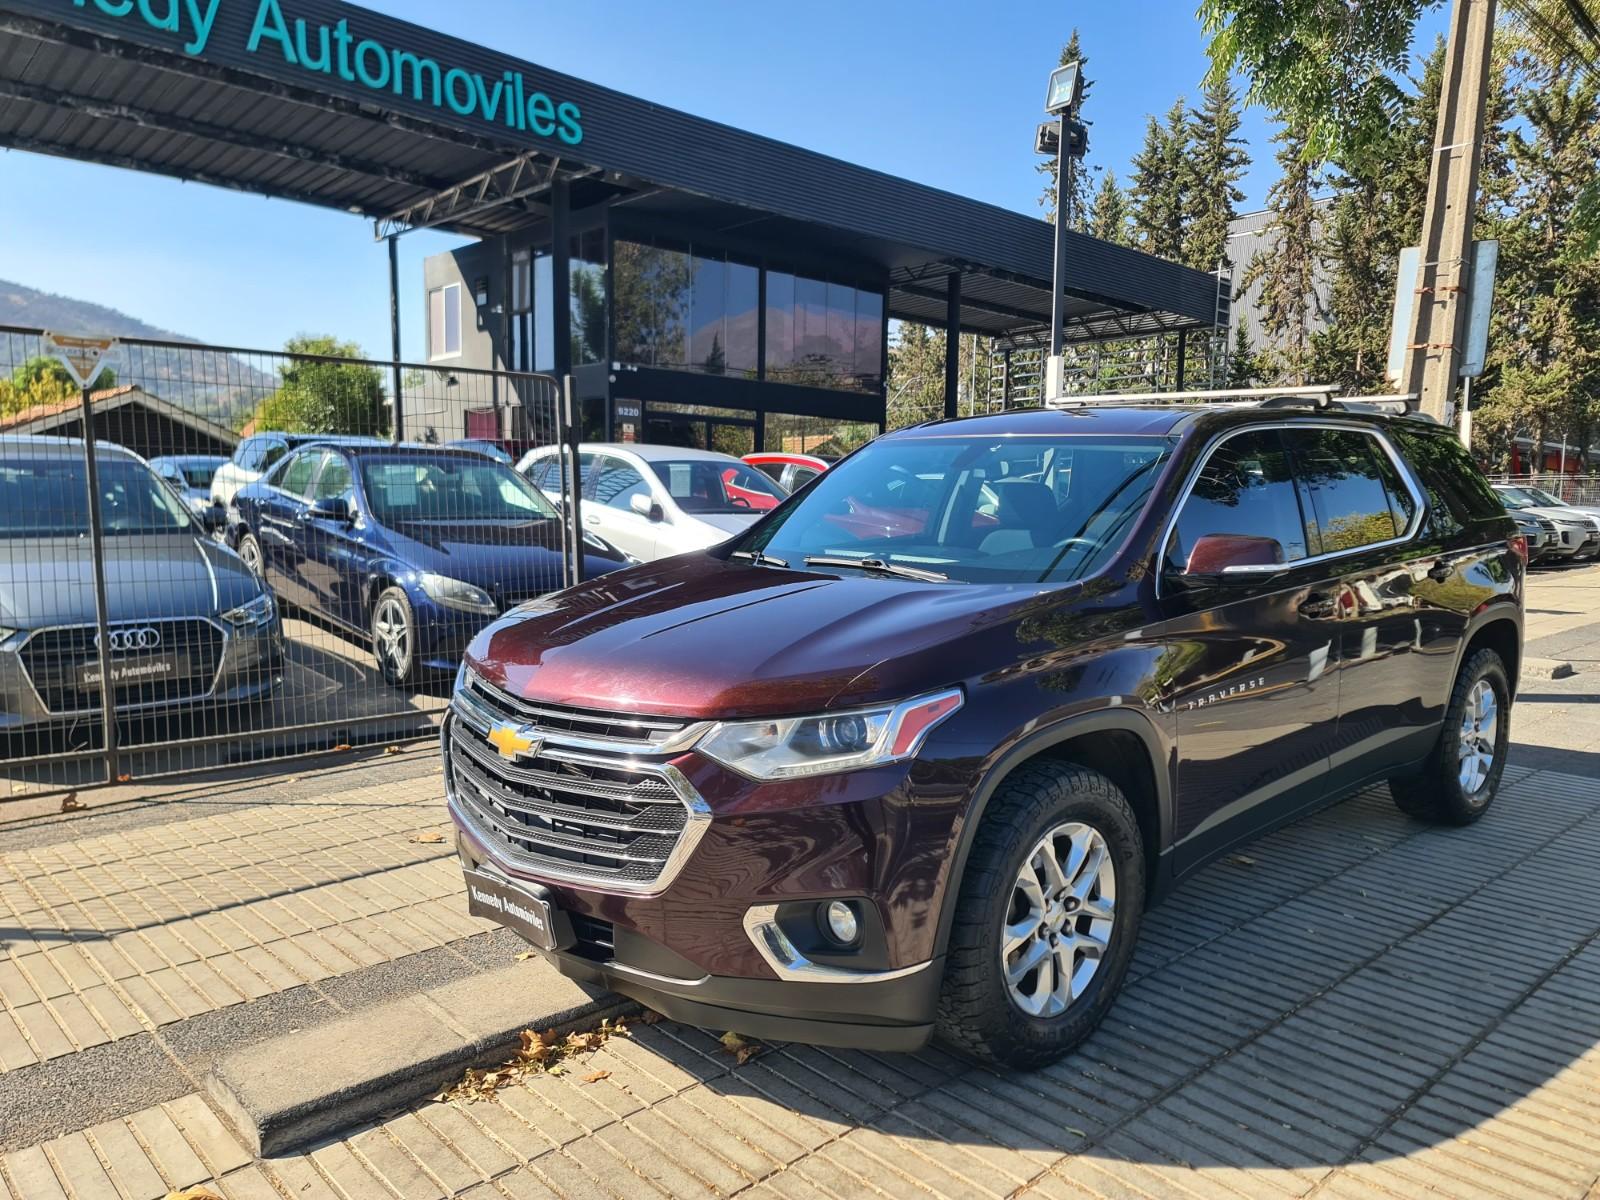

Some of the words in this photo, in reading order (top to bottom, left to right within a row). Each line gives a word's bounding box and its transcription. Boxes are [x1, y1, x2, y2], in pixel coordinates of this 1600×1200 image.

[246, 0, 583, 145] Automoviles
[1188, 677, 1265, 711] TRAVERSE
[471, 884, 503, 913] Kennedy
